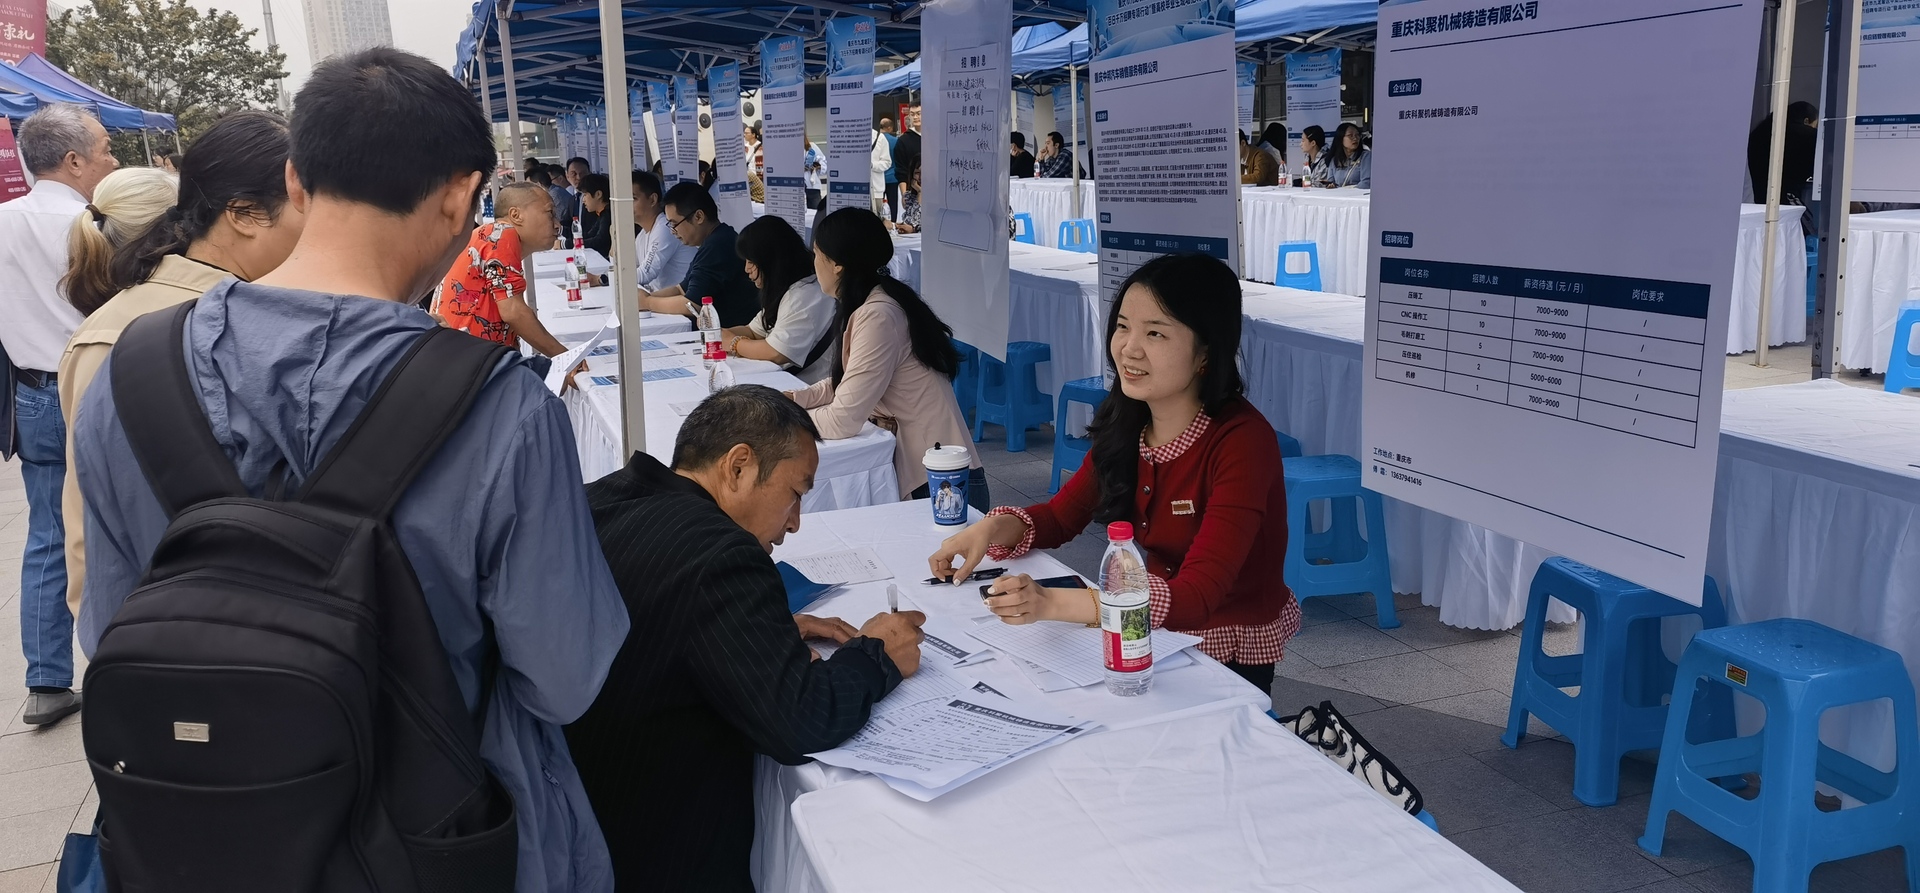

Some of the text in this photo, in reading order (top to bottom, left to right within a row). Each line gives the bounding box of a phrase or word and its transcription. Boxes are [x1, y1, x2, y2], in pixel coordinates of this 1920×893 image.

[1391, 1, 1539, 38] 重庆科聚机械铸造有限公司
[1392, 82, 1418, 93] 企业简介
[1398, 106, 1478, 120] 重庆科聚机械铸造有限公司
[1384, 234, 1409, 246] 招聘岗位
[1404, 267, 1430, 279] 岗位名称
[1472, 273, 1499, 286] 招聘人数
[1631, 289, 1665, 303] 岗位要求
[1400, 310, 1412, 318] CNC
[1536, 305, 1569, 317] 7000-9000
[1534, 328, 1567, 340] 7000-9000
[1532, 350, 1564, 363] 7000-9000
[1405, 370, 1416, 379] 机修
[1530, 373, 1562, 386] 5000-6000
[1528, 395, 1560, 408] 7000-9000
[1396, 453, 1412, 465] 重庆市
